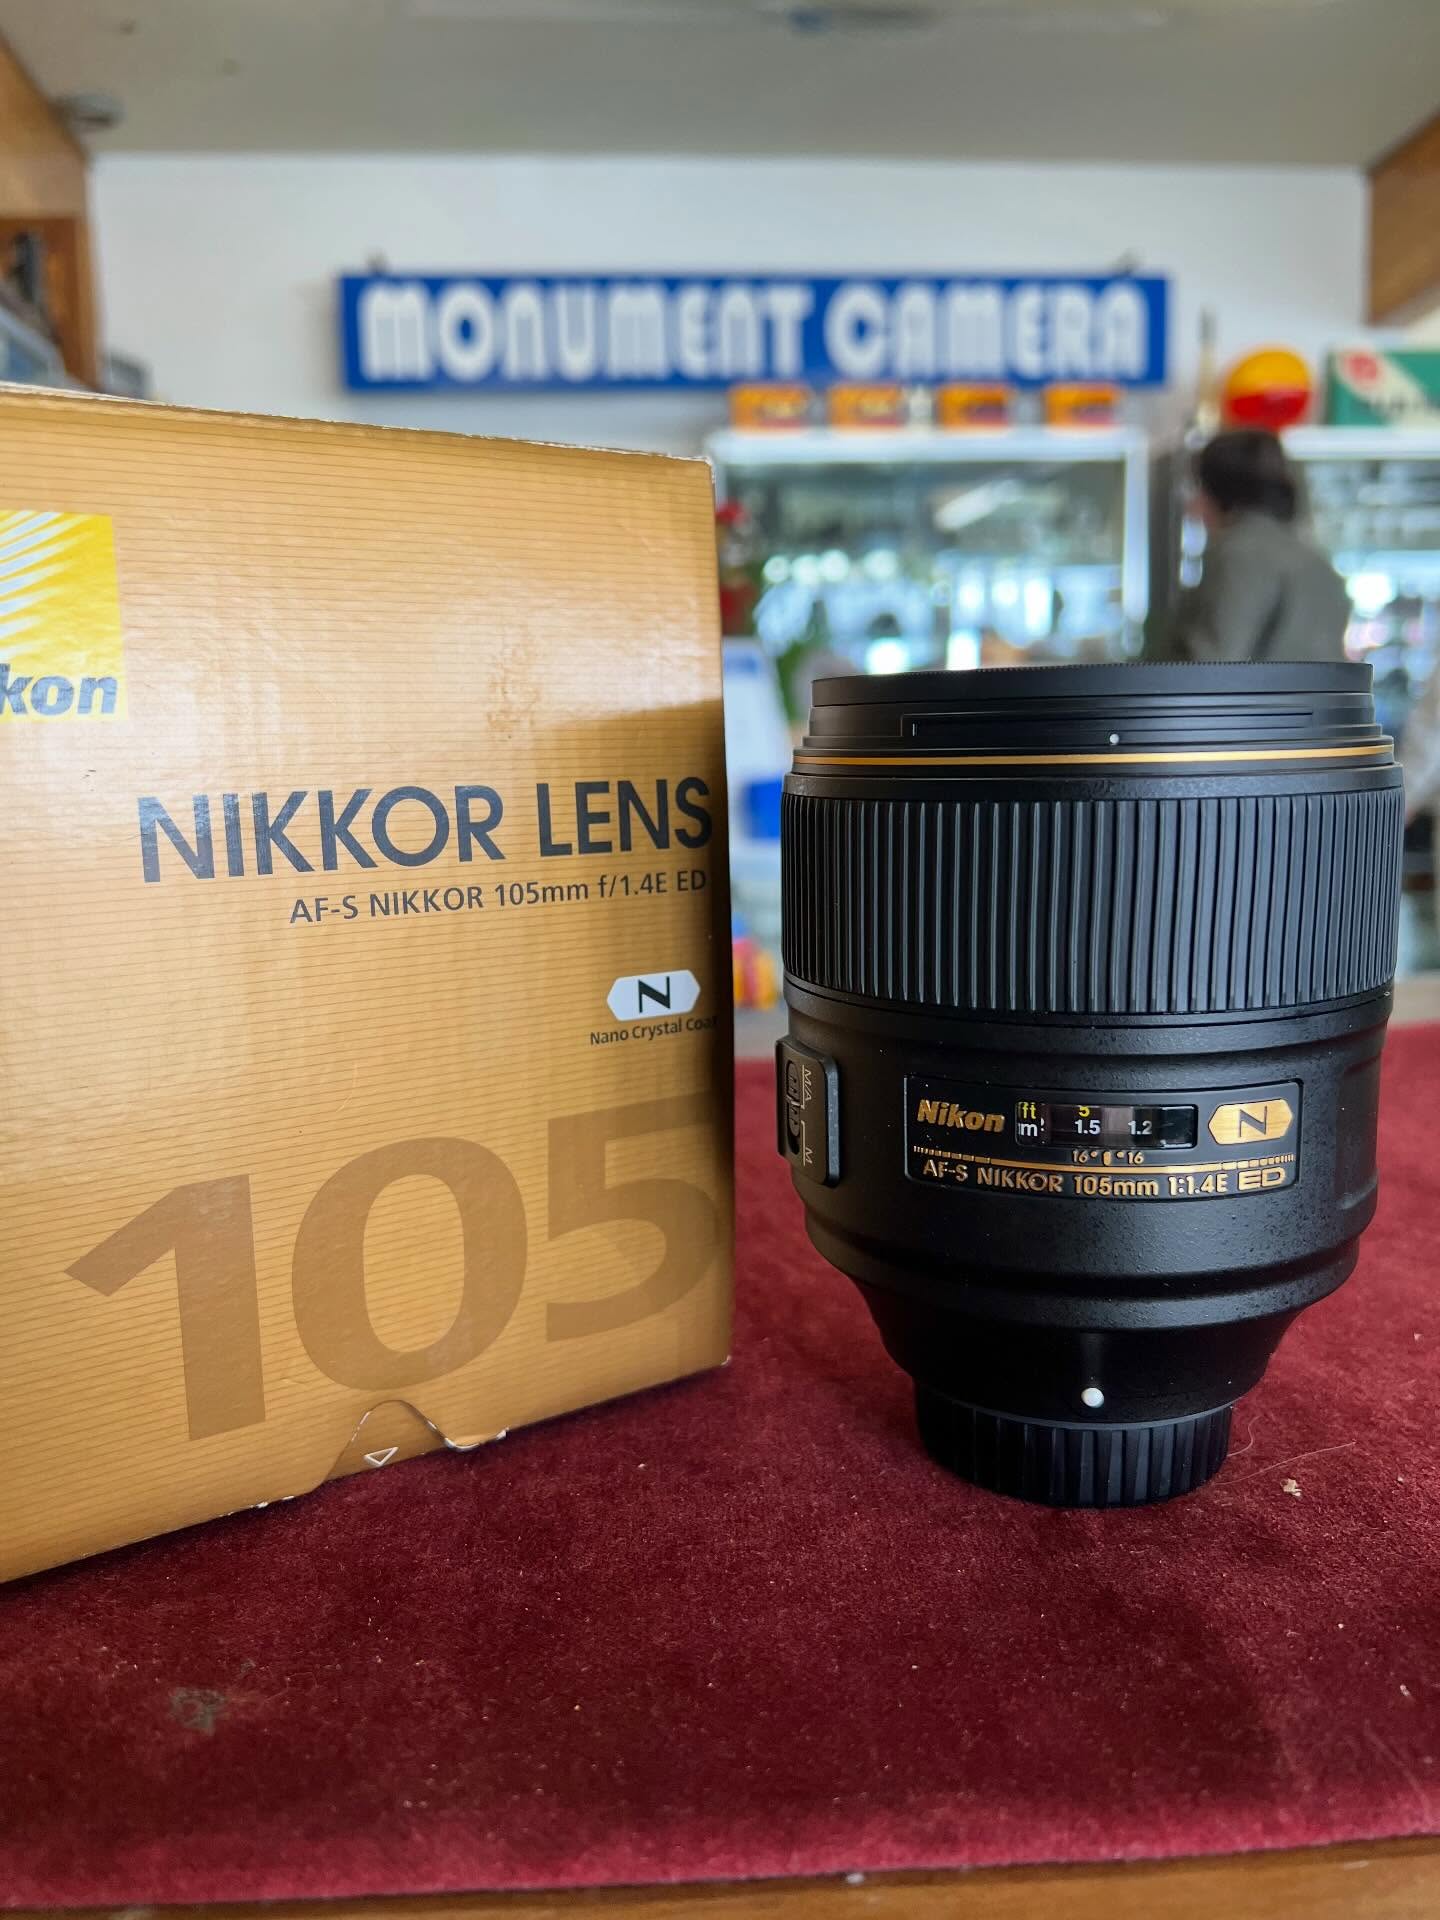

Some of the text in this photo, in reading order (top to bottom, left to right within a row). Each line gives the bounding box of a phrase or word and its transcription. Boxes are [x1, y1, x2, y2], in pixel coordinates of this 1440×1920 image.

[361, 282, 1148, 380] MONUMENT CAMERA
[137, 777, 713, 883] NIKKOR LENS
[290, 870, 706, 924] AF-S NIKKOR 105mm f/1.4E ED
[638, 976, 671, 1013] N
[590, 1030, 629, 1046] Nano
[632, 1018, 682, 1041] Crystal
[917, 1099, 1005, 1133] Nikon
[1022, 1101, 1037, 1119] ft
[1238, 1105, 1268, 1138] N
[1018, 1122, 1038, 1137] m
[1074, 1119, 1101, 1135] 1.5
[1127, 1120, 1153, 1135] 1.2
[1072, 1149, 1144, 1165] 16 16
[923, 1159, 1286, 1196] AF-S NIKKOR 105mm 1:1.4E ED
[64, 1089, 724, 1441] 105
